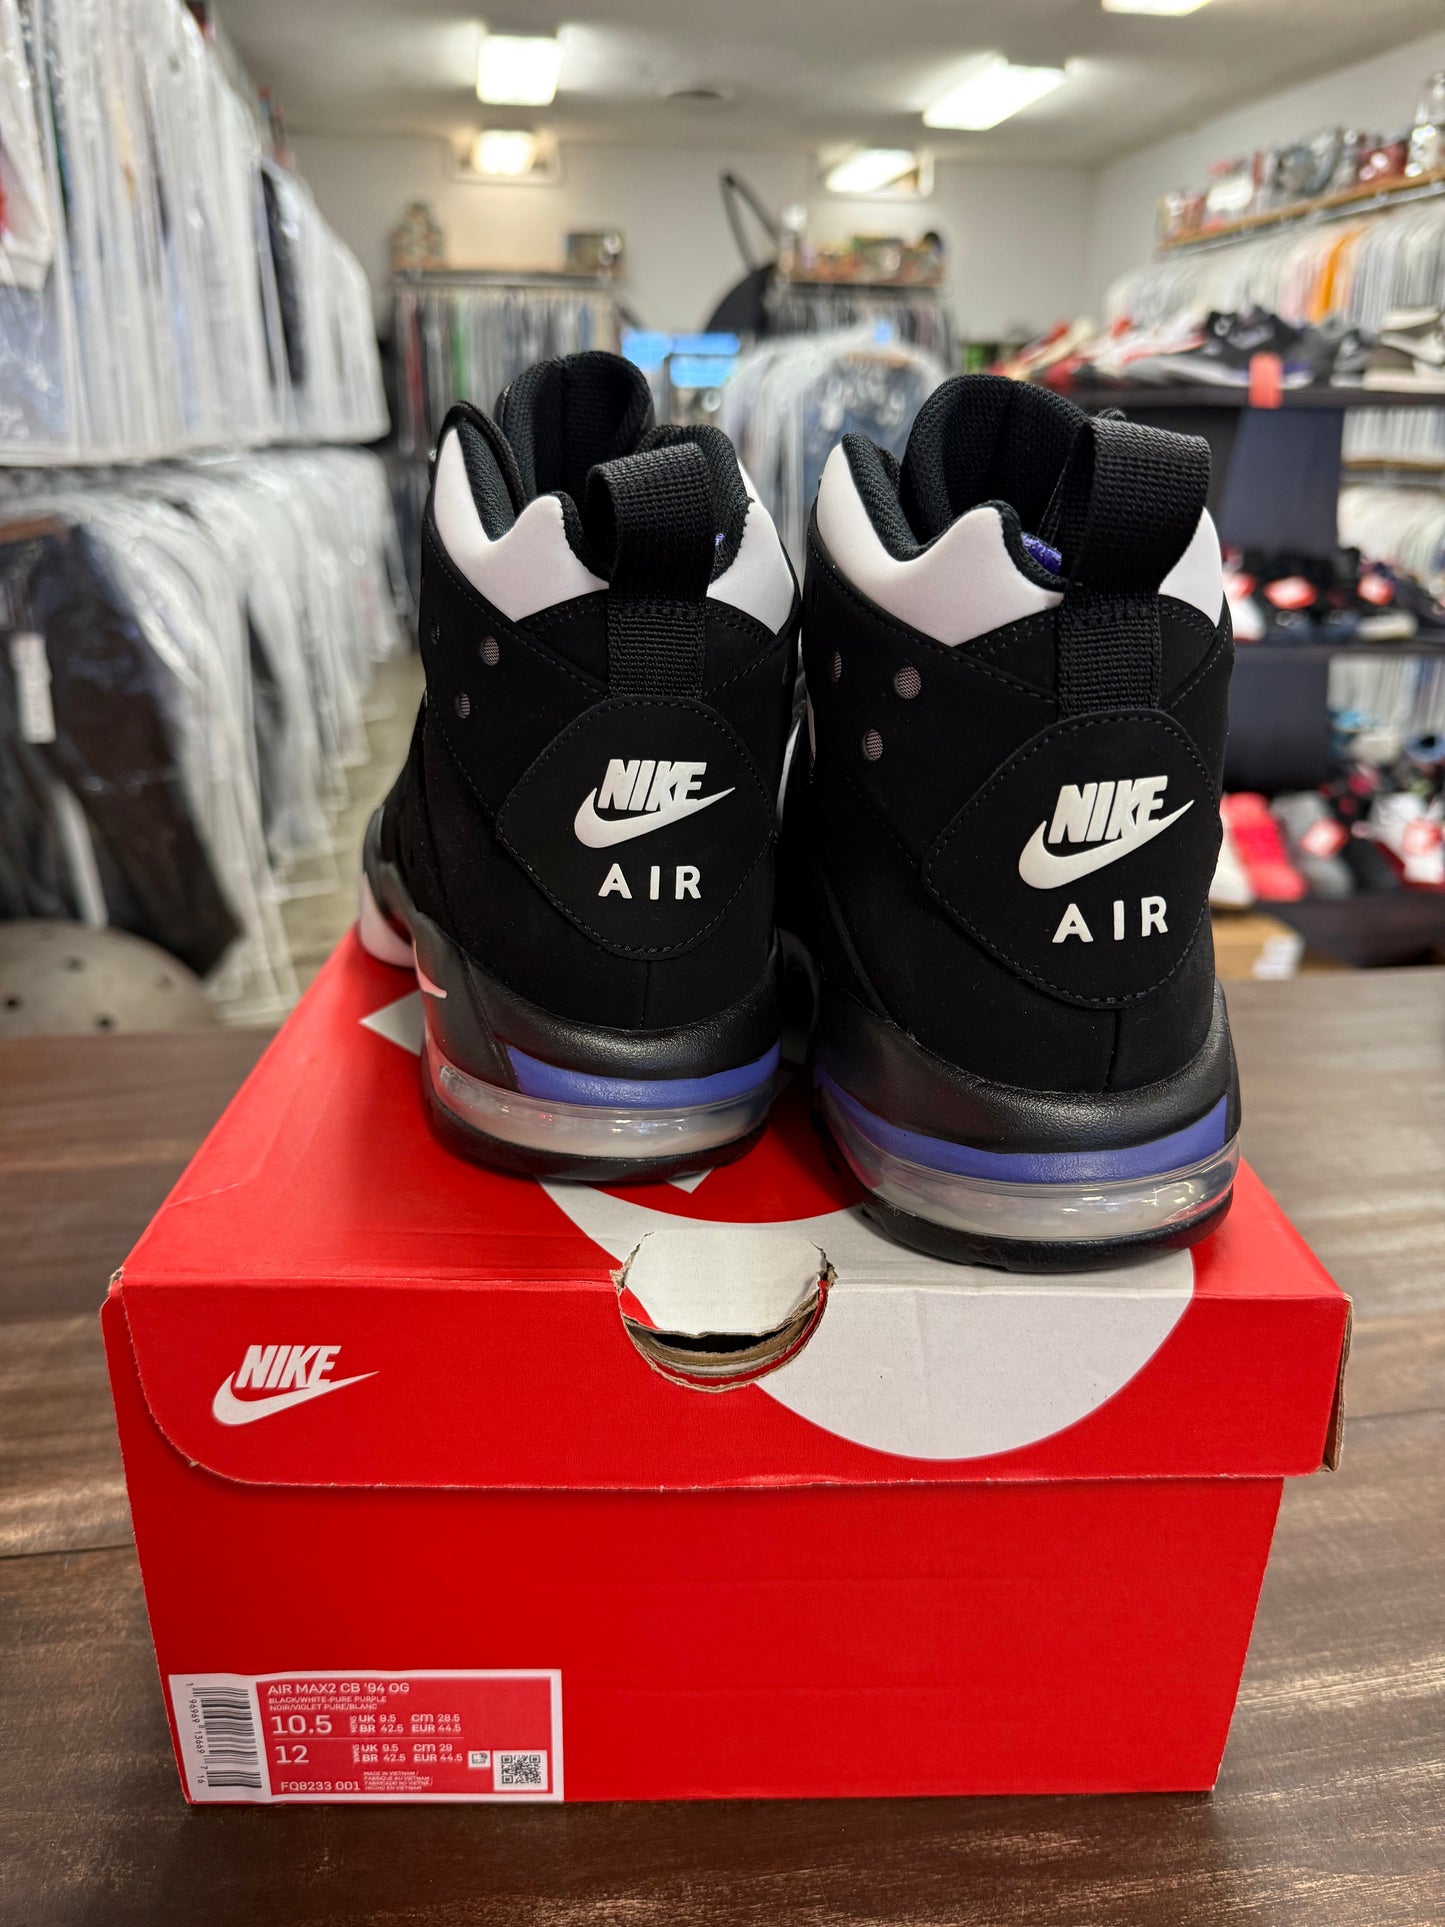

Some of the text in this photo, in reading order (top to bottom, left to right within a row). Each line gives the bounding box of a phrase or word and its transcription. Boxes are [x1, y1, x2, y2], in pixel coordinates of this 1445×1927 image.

[598, 759, 707, 811] NIKE
[1048, 775, 1168, 844] NIKE
[598, 863, 702, 900] AIR
[1052, 895, 1169, 943] AIR
[234, 1345, 342, 1388] NIKE
[268, 1684, 292, 1695] AIR
[296, 1683, 337, 1694] MAX2
[340, 1682, 361, 1693] CB
[389, 1682, 410, 1693] OG
[189, 1698, 200, 1723] 96969
[269, 1703, 322, 1711] NOIR/VIOLET
[271, 1714, 333, 1734] 10.5
[359, 1714, 375, 1723] UK
[379, 1714, 397, 1723] 9.5
[437, 1713, 460, 1722] 28.5
[360, 1723, 462, 1733] BR 42.5 EUR 44.5
[194, 1731, 206, 1754] 13669
[361, 1743, 378, 1753] UK
[382, 1743, 399, 1752] 9.5
[439, 1743, 453, 1752] 29
[275, 1744, 310, 1764] 12
[362, 1753, 463, 1763] BR 42.5 EUR 44.5
[281, 1780, 361, 1792] FQ8233 001
